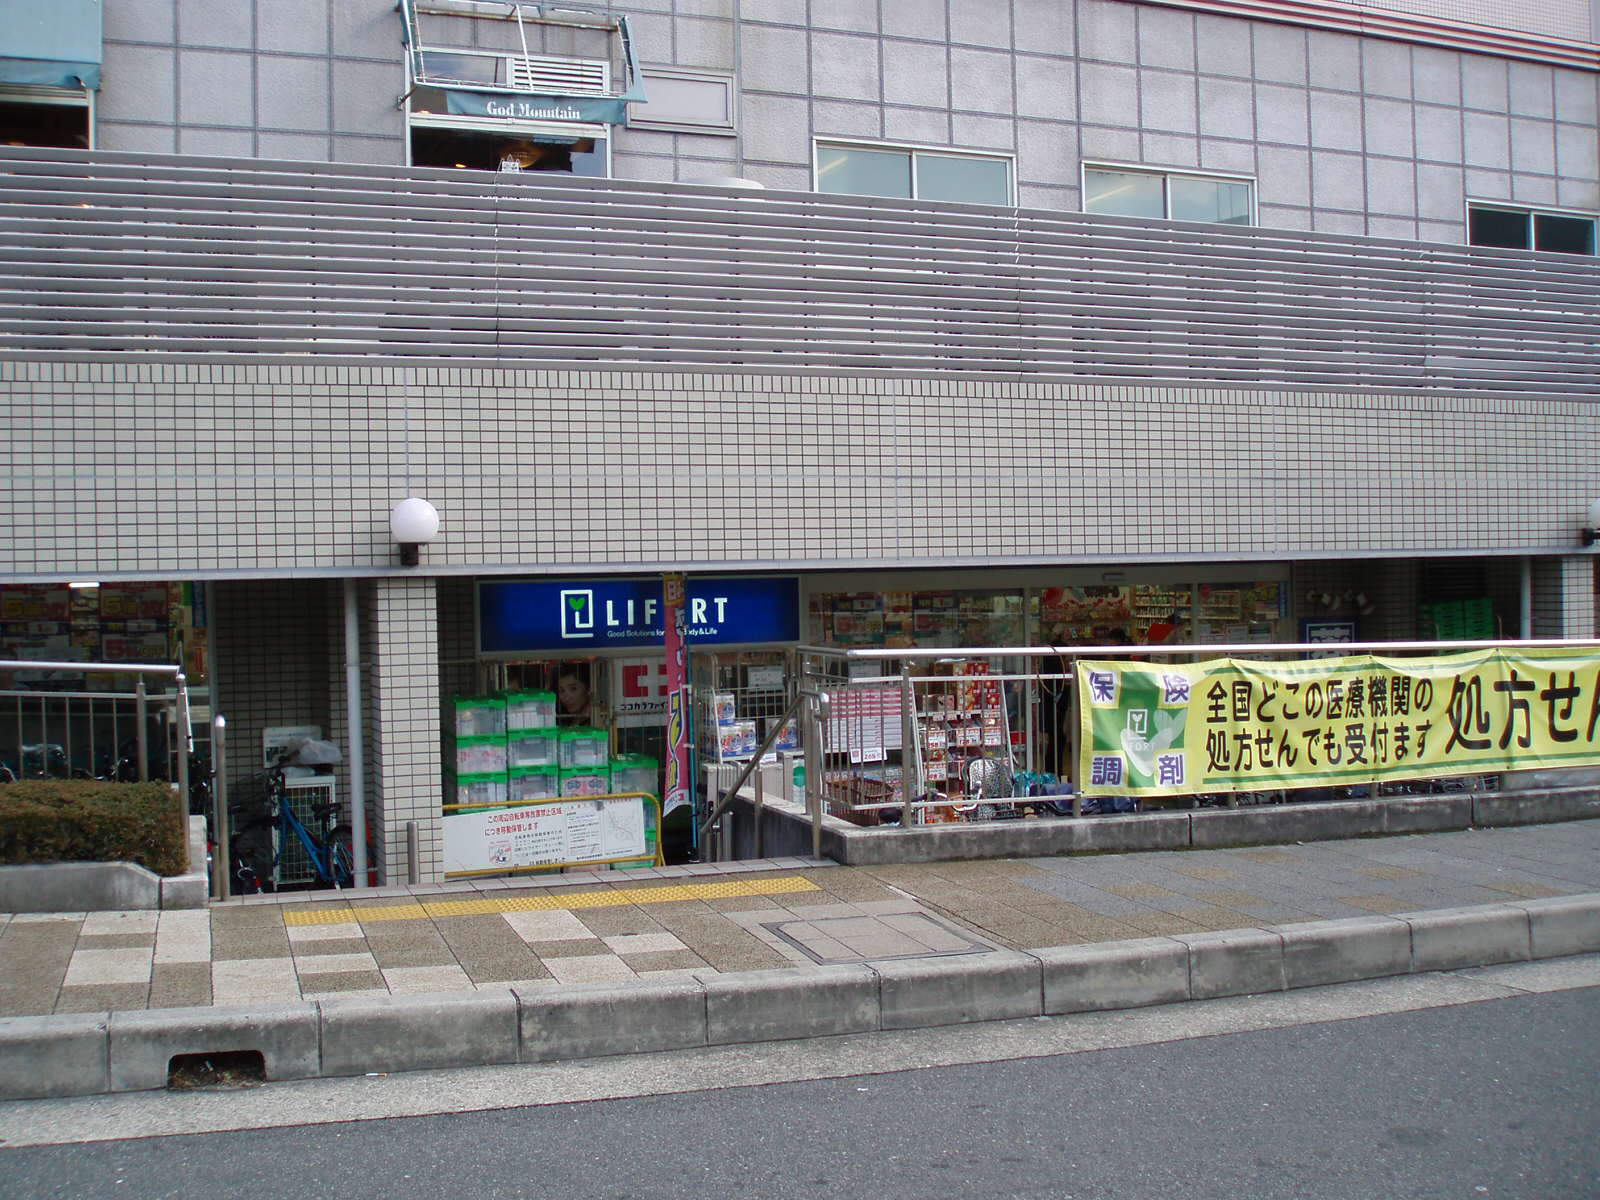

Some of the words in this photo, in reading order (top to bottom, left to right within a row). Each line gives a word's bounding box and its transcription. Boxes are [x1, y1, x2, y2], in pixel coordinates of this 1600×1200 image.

[486, 101, 514, 116] God
[519, 103, 580, 119] Mountain
[606, 597, 728, 626] LIFRT
[607, 630, 625, 638] Good
[626, 629, 656, 637] Solutions
[1089, 671, 1114, 701] 保
[1163, 674, 1189, 703] 険
[1206, 675, 1433, 724] 全国どこの医療機関の
[615, 701, 666, 711] ココカラファイ
[1205, 719, 1432, 773] 処方せんでも受付ます
[1092, 756, 1122, 785] 調
[1158, 754, 1184, 785] 剤
